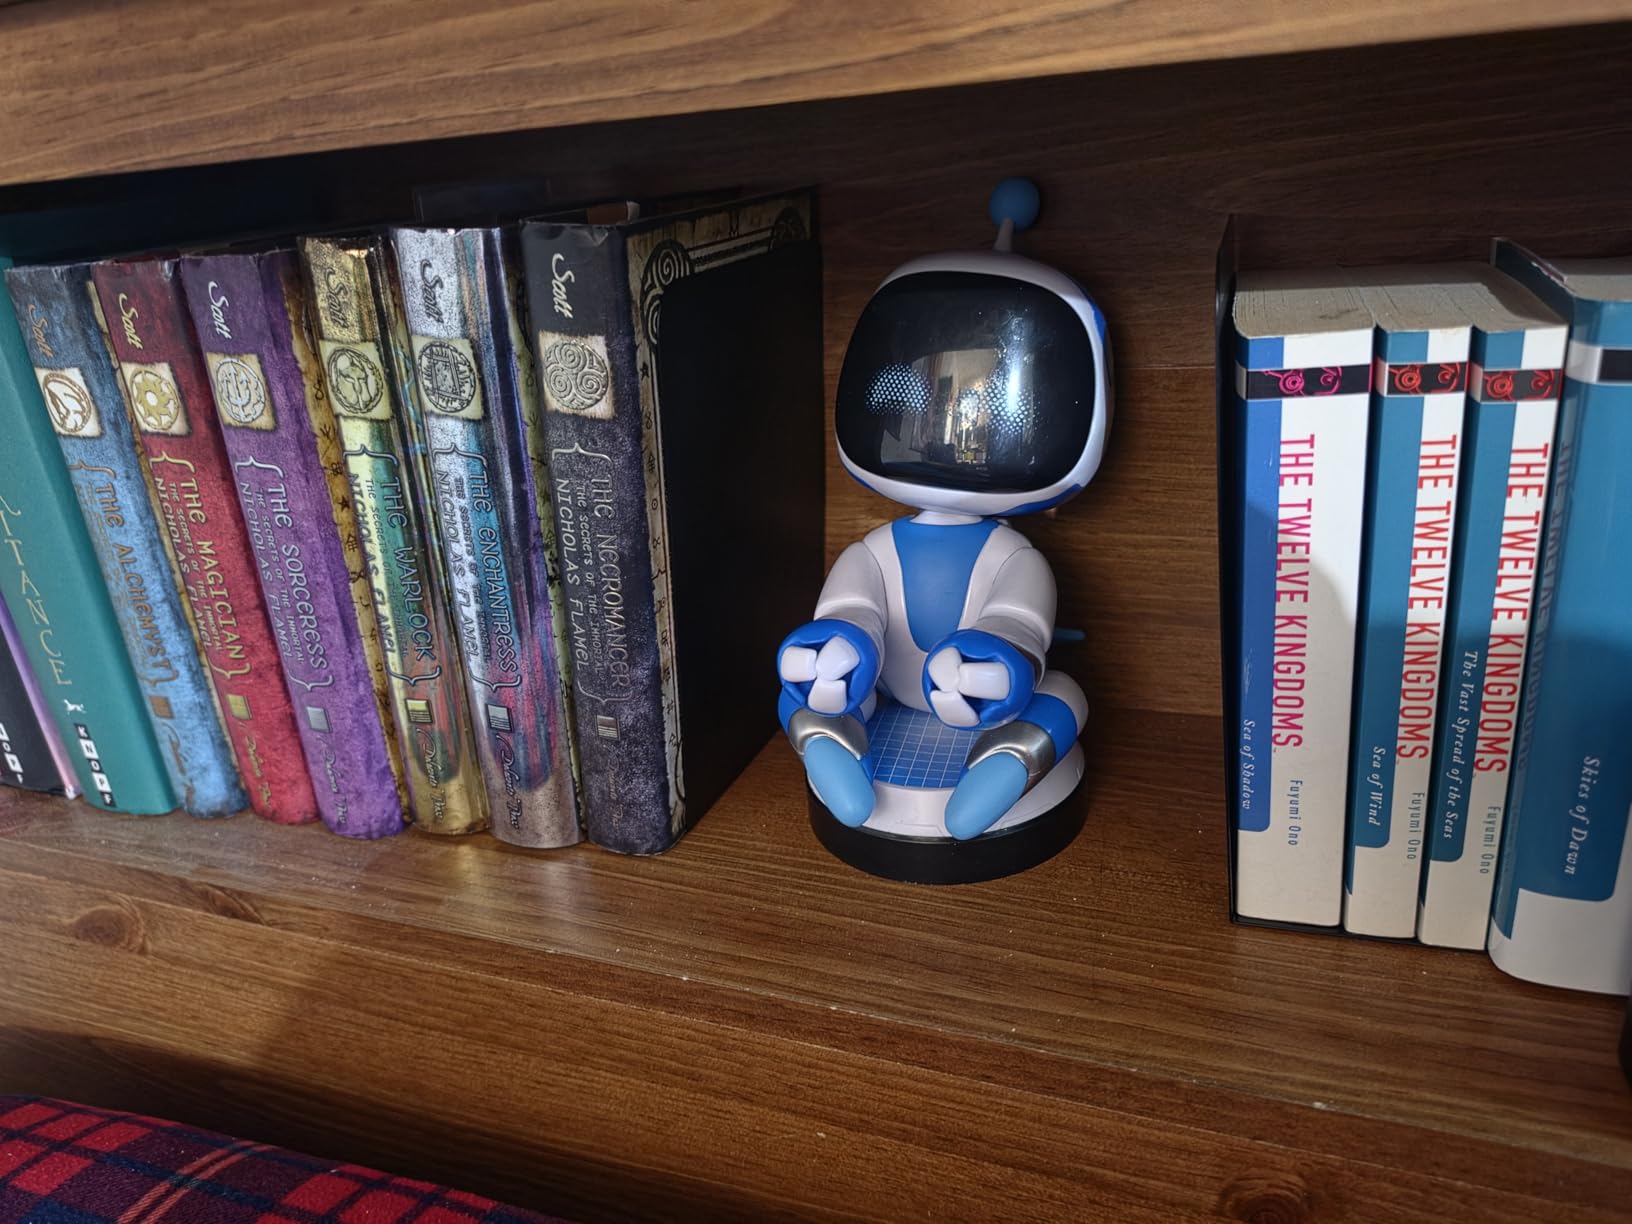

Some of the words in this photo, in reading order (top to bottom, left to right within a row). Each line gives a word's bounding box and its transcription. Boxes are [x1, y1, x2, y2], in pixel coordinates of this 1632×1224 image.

[208, 281, 232, 340] Scott
[551, 253, 575, 319] Scott
[119, 293, 143, 350] Scott
[1280, 434, 1315, 486] THE
[1417, 434, 1457, 489] THE
[1507, 443, 1548, 499] THE
[381, 477, 408, 528] THE
[469, 470, 493, 513] THE
[591, 474, 615, 519] THE
[349, 473, 379, 576] NICHOLAS
[1275, 498, 1312, 603] TWELVE
[155, 477, 190, 573] NICHOLAS
[187, 585, 212, 647] FLAMEL
[180, 478, 207, 524] THE
[197, 541, 246, 659] MAGICIAN
[240, 482, 272, 581] NICHOLAS
[268, 594, 292, 657] FLAMEL
[268, 484, 293, 528] THE
[282, 544, 328, 669] SORCERESS
[437, 470, 465, 577] NICHOLAS
[457, 588, 479, 657] FLAMEL
[555, 478, 580, 585] NICHOLAS
[569, 598, 589, 671] FLAMEL
[1407, 501, 1452, 610] TWELVE
[1493, 511, 1540, 621] TWELVE
[0, 496, 72, 685] ITANCE
[112, 542, 172, 667] ALCHEMYST
[394, 547, 436, 661] WARLOCK
[479, 526, 518, 673] ENCHANTRESS
[596, 534, 632, 687] NECROMANCER
[1271, 615, 1308, 748] KINGDOMS
[1462, 651, 1479, 677] The
[1396, 622, 1441, 760] KINGDOMS
[1458, 683, 1475, 711] Vast
[1473, 634, 1525, 774] KINGDOMS
[1239, 745, 1255, 760] of
[1243, 719, 1256, 740] Sea
[1451, 717, 1470, 765] Spread
[76, 724, 115, 806] KNOPF
[1367, 773, 1384, 788] of
[1372, 746, 1386, 768] Sea
[1446, 768, 1463, 785] of
[1578, 756, 1600, 799] Skies
[1241, 762, 1255, 810] Shadow
[1286, 779, 1303, 820] Fuyumi
[1368, 791, 1384, 826] Wind
[1446, 788, 1461, 809] the
[1287, 825, 1302, 846] Ono
[1408, 792, 1425, 833] Fuyumi
[1443, 811, 1458, 839] Seas
[1482, 806, 1501, 848] Fuyumi
[1569, 804, 1591, 825] of
[1406, 839, 1421, 860] Ono
[1479, 853, 1495, 874] Ono
[1564, 826, 1588, 875] Dawn
